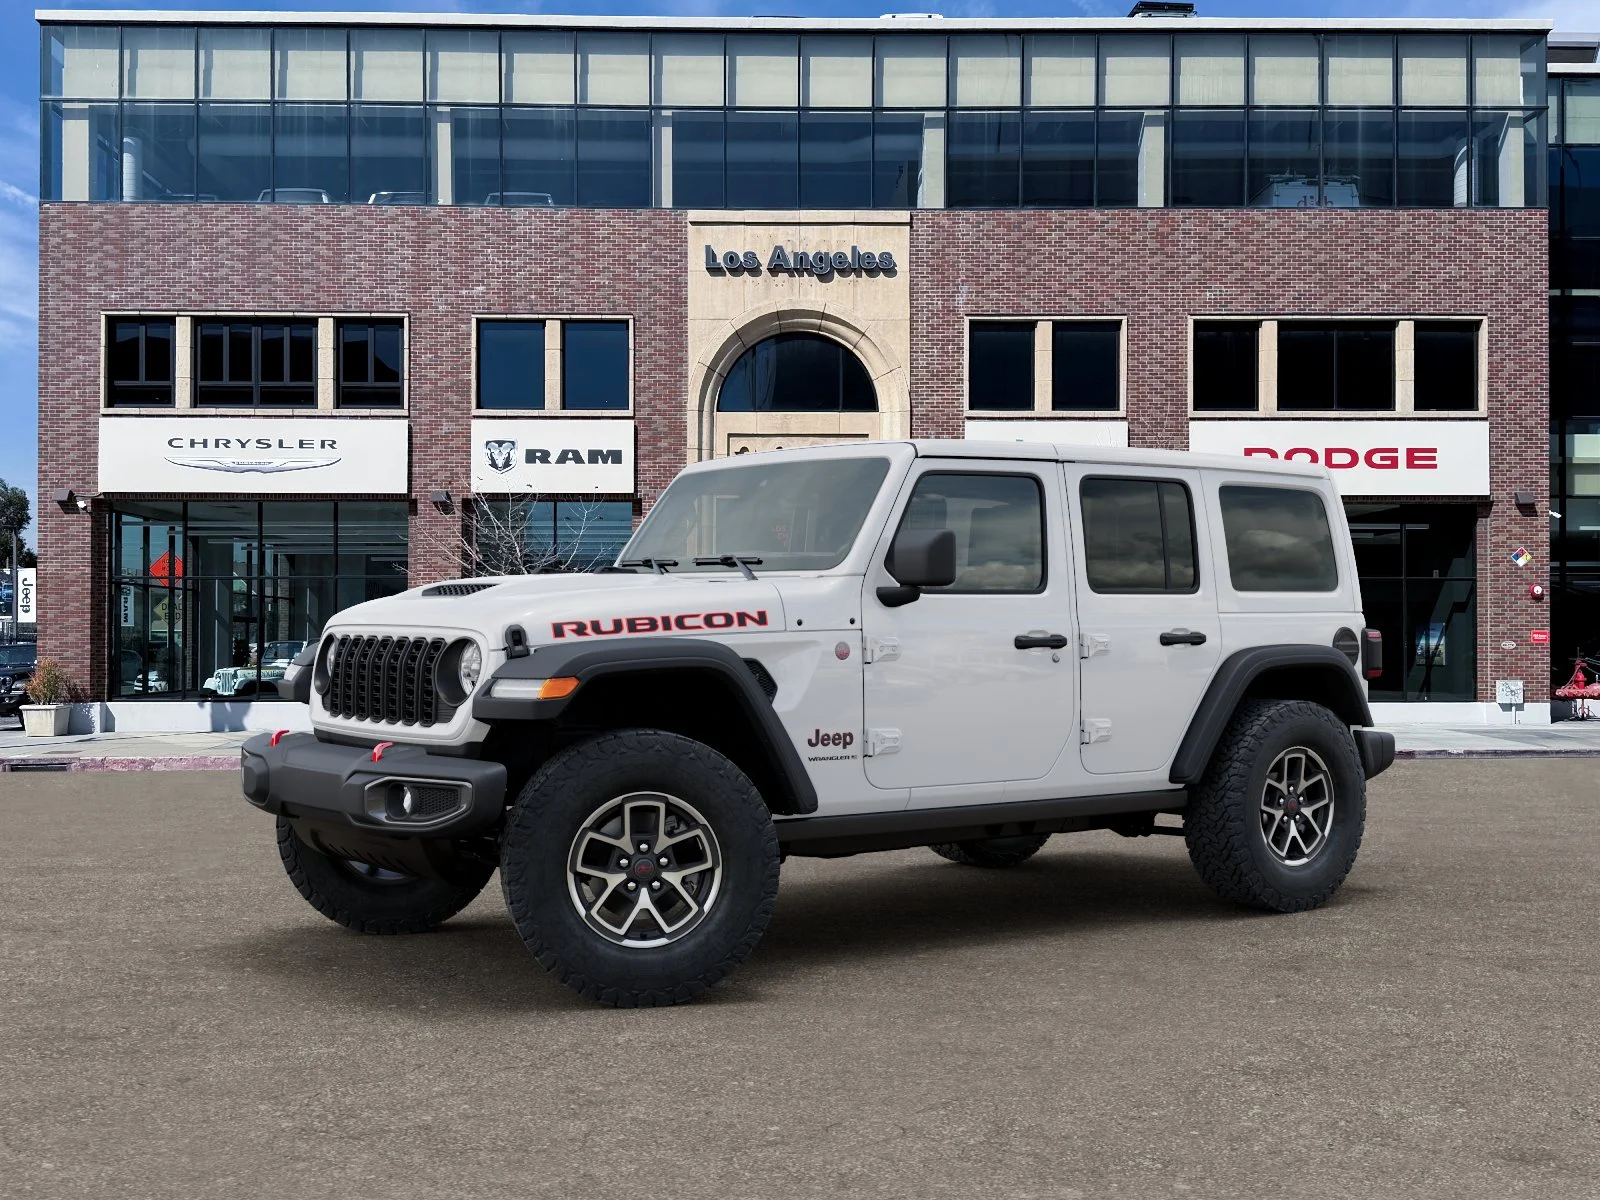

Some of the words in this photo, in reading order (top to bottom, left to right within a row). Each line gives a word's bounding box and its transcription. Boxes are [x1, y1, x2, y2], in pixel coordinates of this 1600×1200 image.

[705, 244, 759, 269] Los
[767, 245, 895, 275] Angeles
[167, 437, 338, 450] CHRYSLER
[525, 449, 623, 465] RAM
[20, 577, 34, 614] Jeep
[164, 612, 181, 620] ED
[551, 610, 769, 639] RUBICON
[807, 728, 854, 750] Jeep
